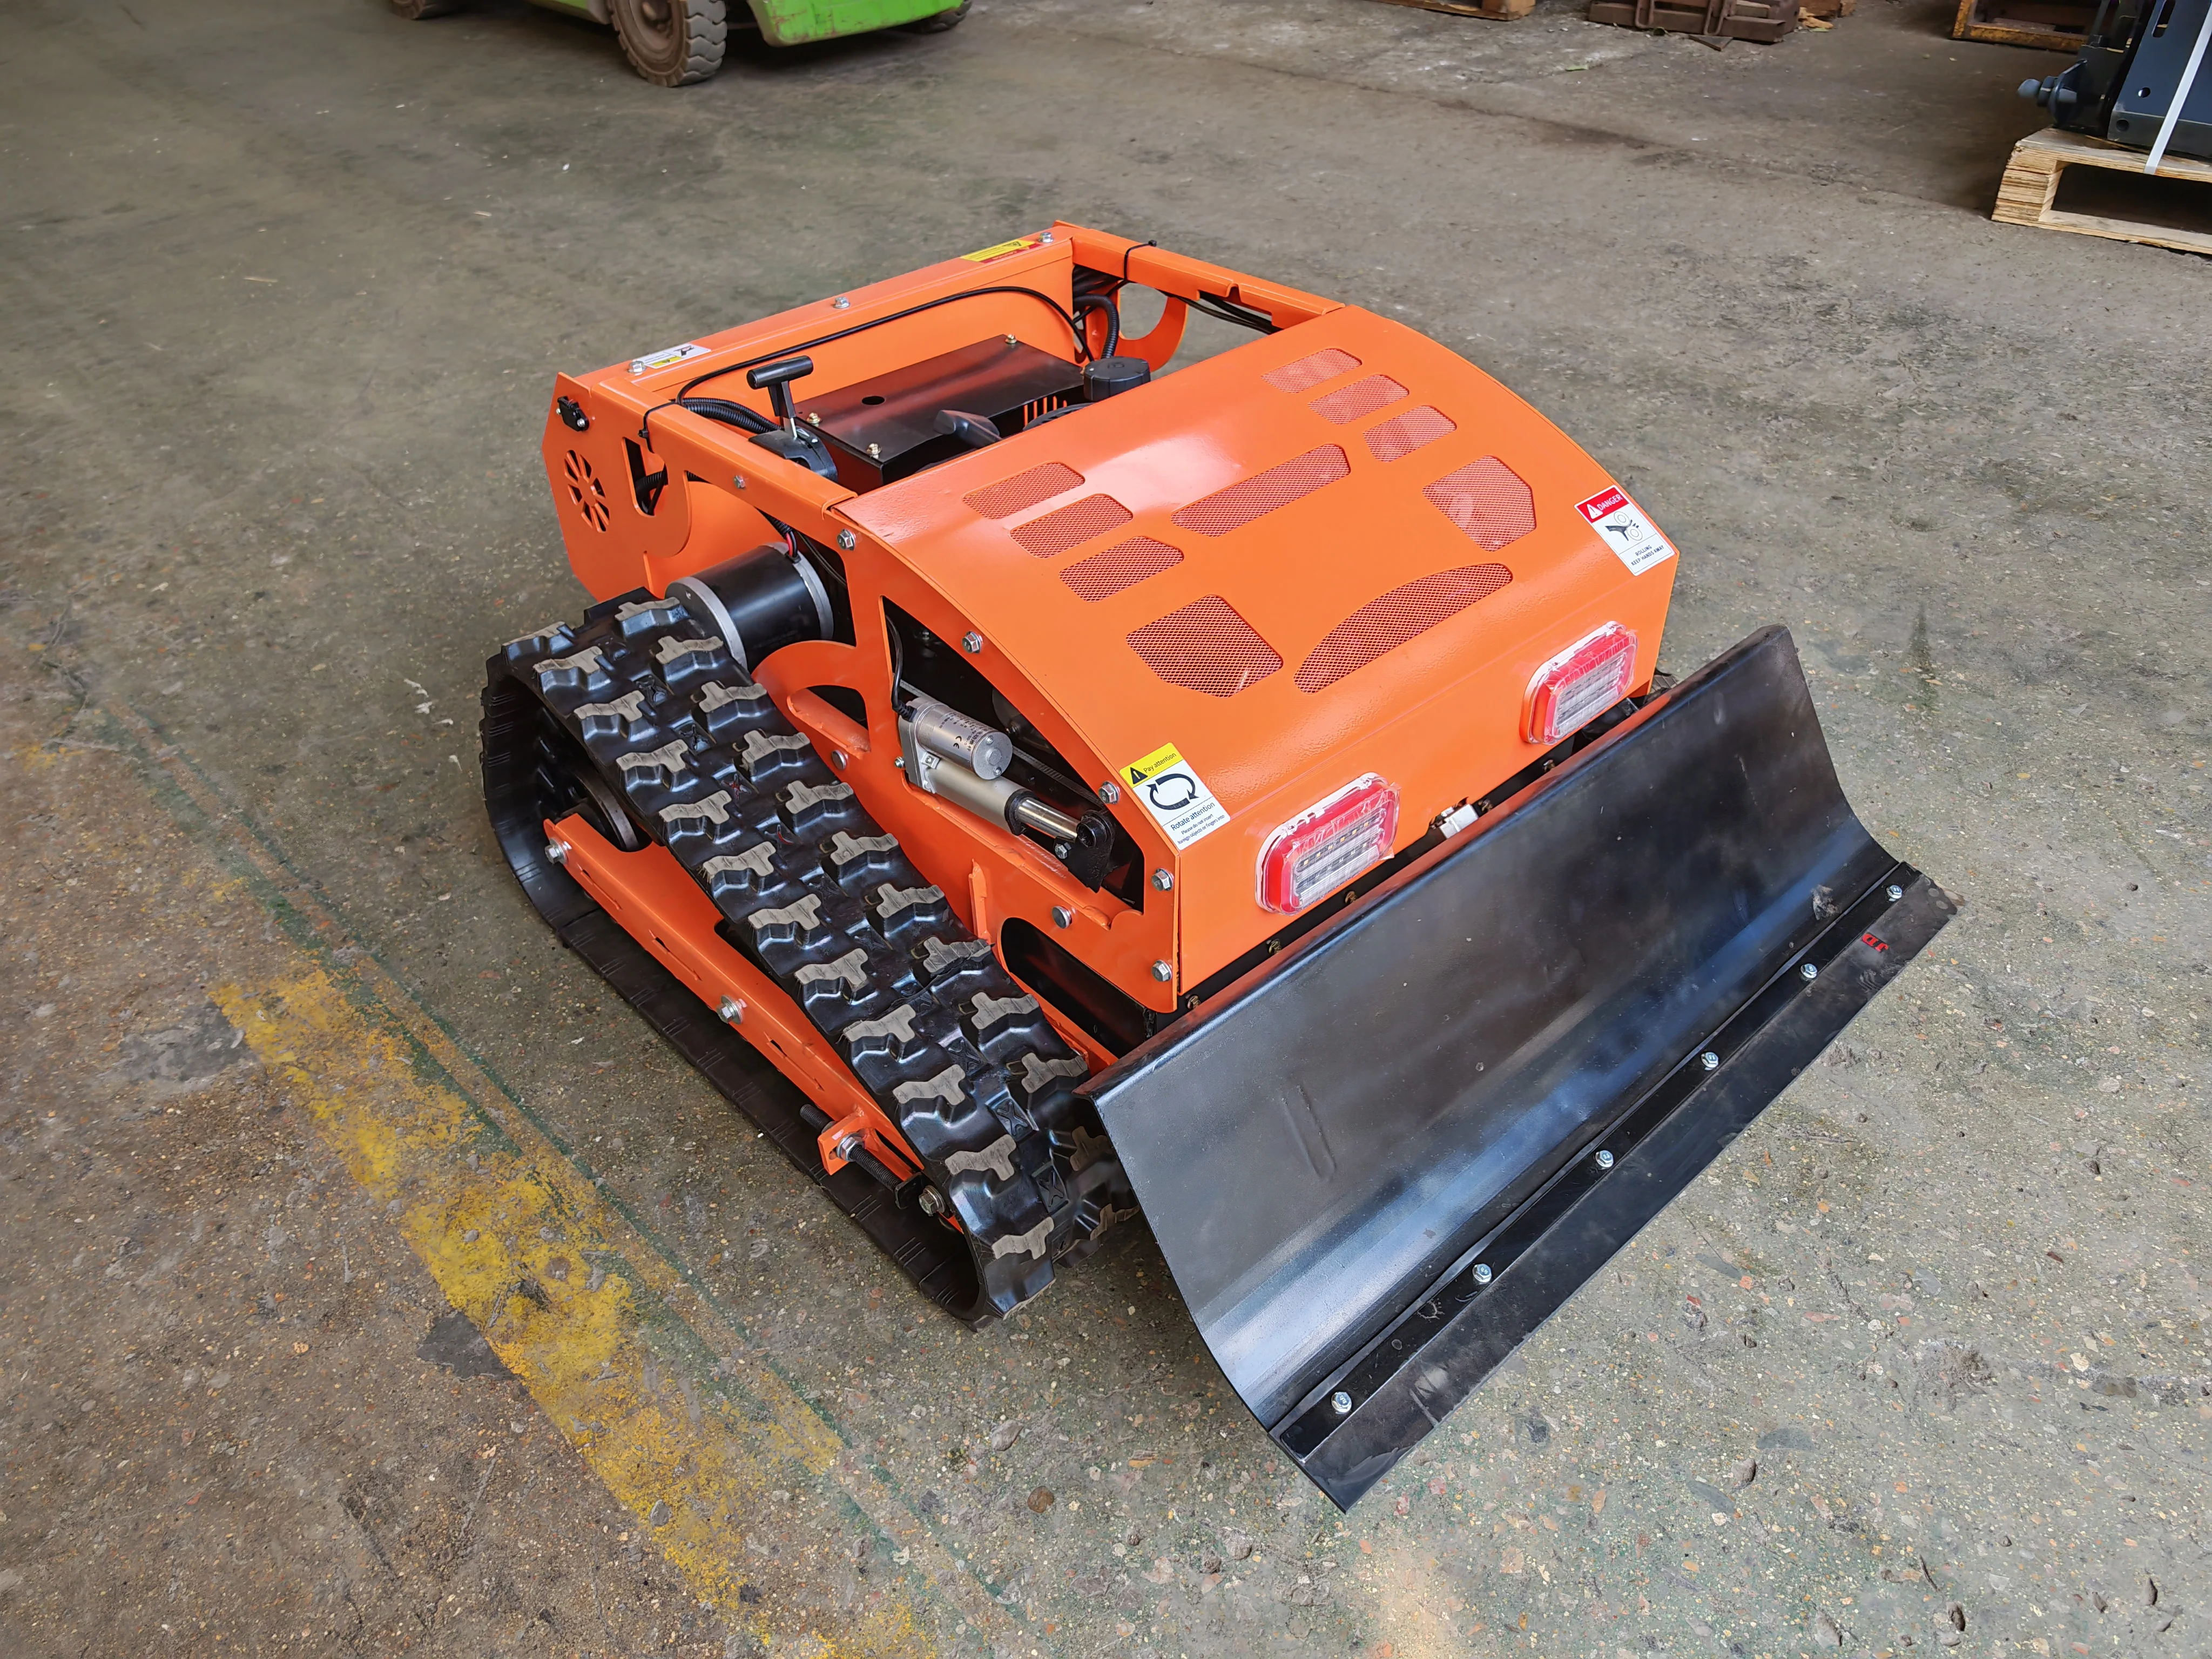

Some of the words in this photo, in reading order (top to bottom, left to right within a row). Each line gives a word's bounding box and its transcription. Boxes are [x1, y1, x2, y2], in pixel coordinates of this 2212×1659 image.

[1597, 494, 1623, 510] DANGER
[1631, 558, 1641, 566] KEEP
[1641, 551, 1654, 560] HANDS
[1654, 545, 1664, 553] AWAY
[1635, 545, 1652, 556] ROLLING
[1143, 765, 1154, 773] Pay
[1154, 753, 1177, 767] attention
[1170, 817, 1190, 831] Rotate
[1189, 802, 1215, 820] attention
[1181, 826, 1193, 834] Please
[1203, 814, 1213, 822] insert
[1190, 828, 1203, 837] objects
[1206, 819, 1218, 827] fingers
